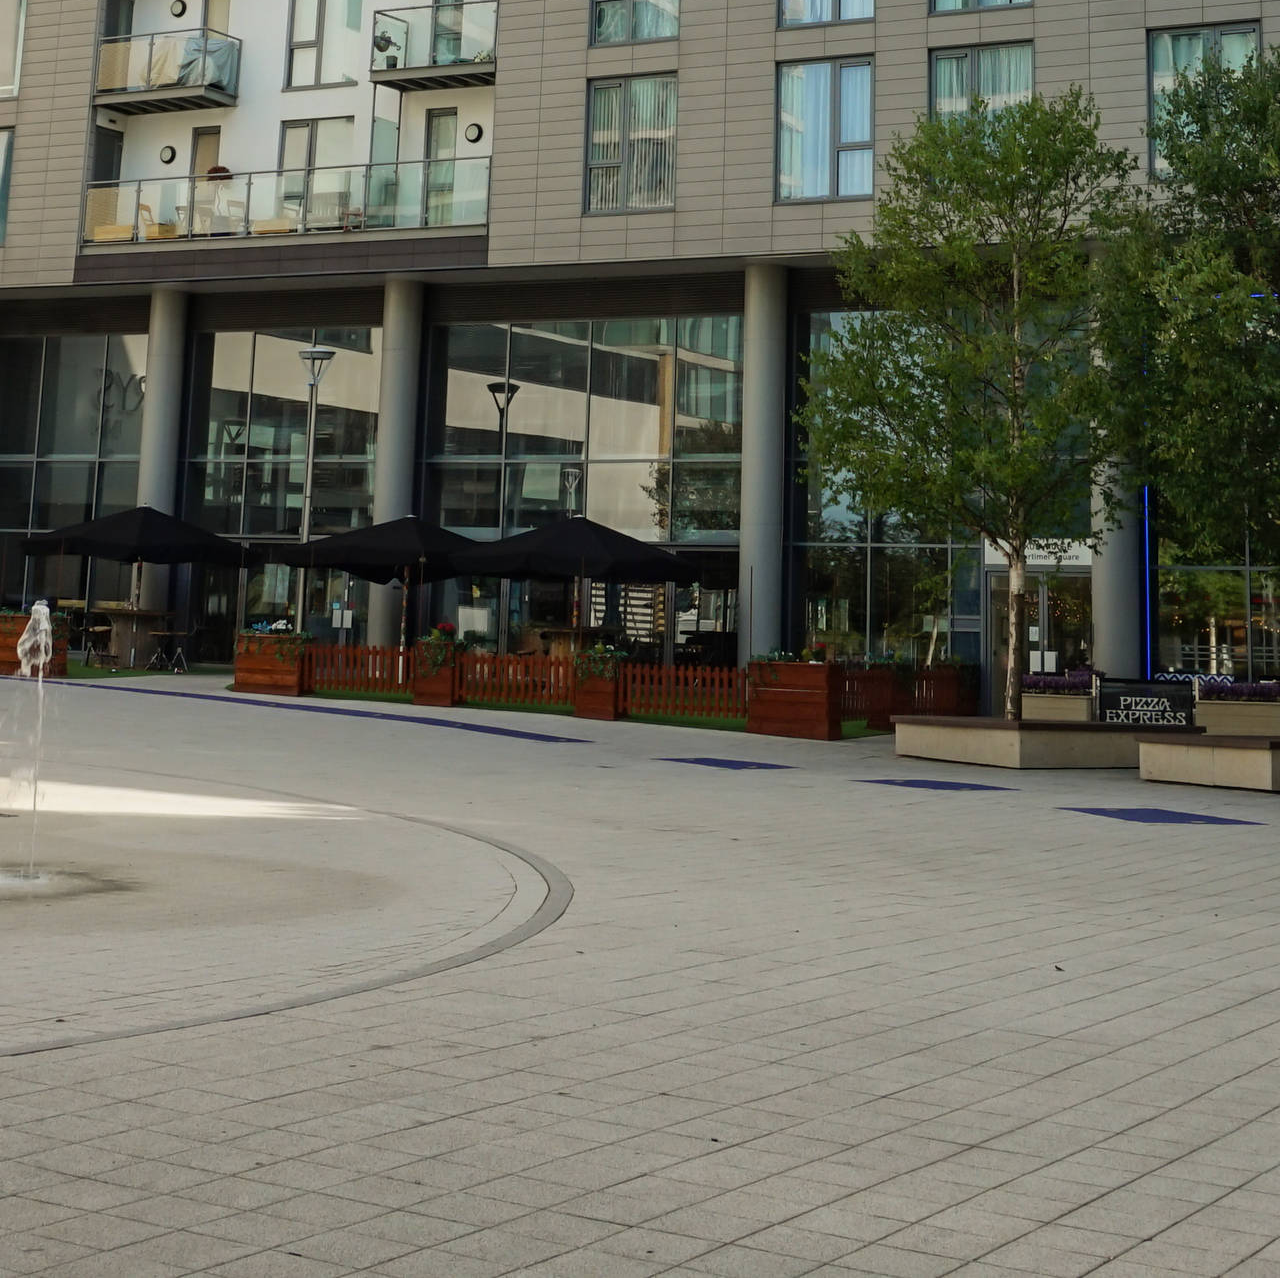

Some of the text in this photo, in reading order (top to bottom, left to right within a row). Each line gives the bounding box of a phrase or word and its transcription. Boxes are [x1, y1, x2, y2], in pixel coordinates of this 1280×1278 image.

[1024, 553, 1081, 563] rtimer Square
[1119, 696, 1172, 711] PIZZA
[1105, 710, 1187, 725] EXPRESS
